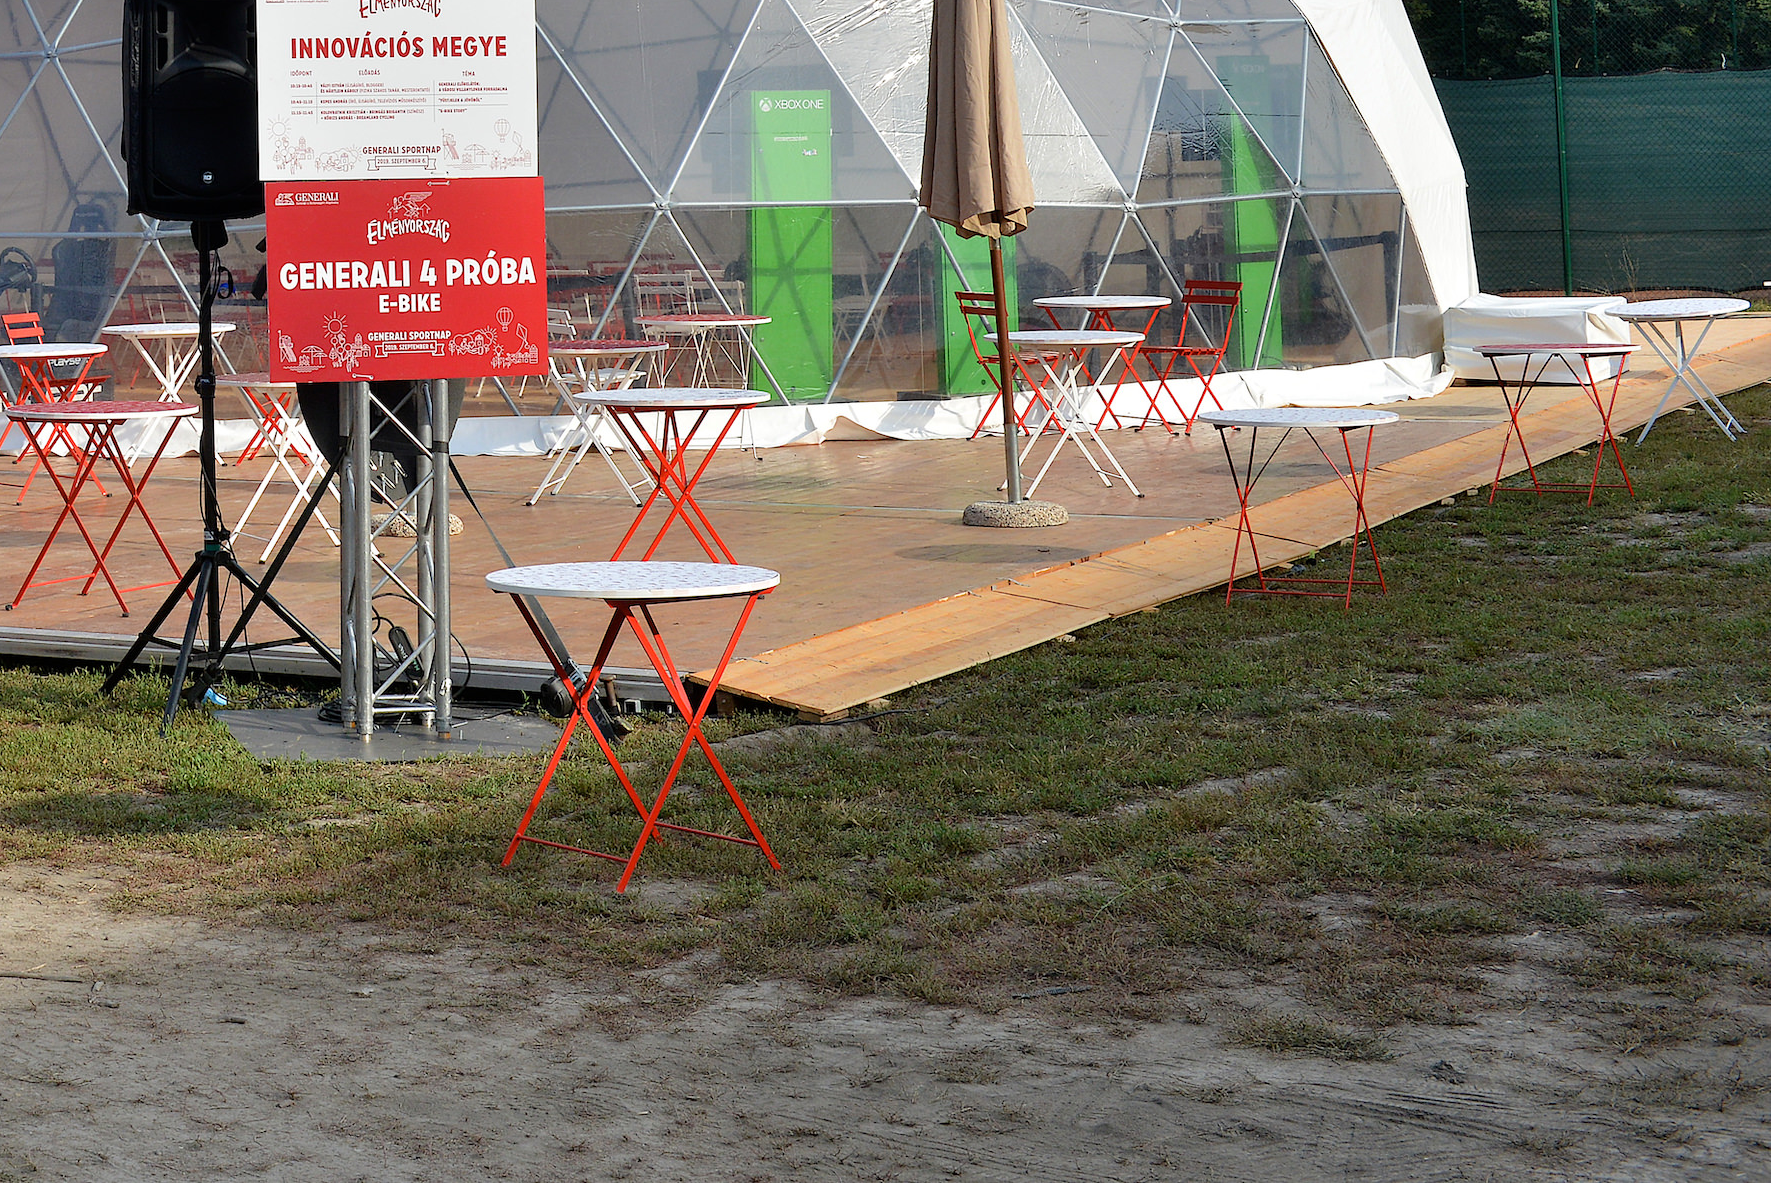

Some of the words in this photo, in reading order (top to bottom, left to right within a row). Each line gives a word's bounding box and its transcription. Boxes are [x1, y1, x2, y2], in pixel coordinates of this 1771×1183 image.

[291, 31, 424, 59] INNOVÁCIÓS
[432, 35, 507, 57] MEGYE
[362, 146, 399, 154] GENERALI
[401, 145, 441, 154] SPORTNAP
[295, 192, 339, 201] GENERALI
[367, 218, 450, 245] ÉLMÉNYORSZÁG
[279, 260, 410, 290] GENERALI
[419, 259, 437, 287] 4
[445, 250, 536, 286] PRÓBA
[378, 293, 441, 313] E-BIKE
[368, 331, 407, 341] GENERALI
[409, 330, 451, 340] SPORTNAP
